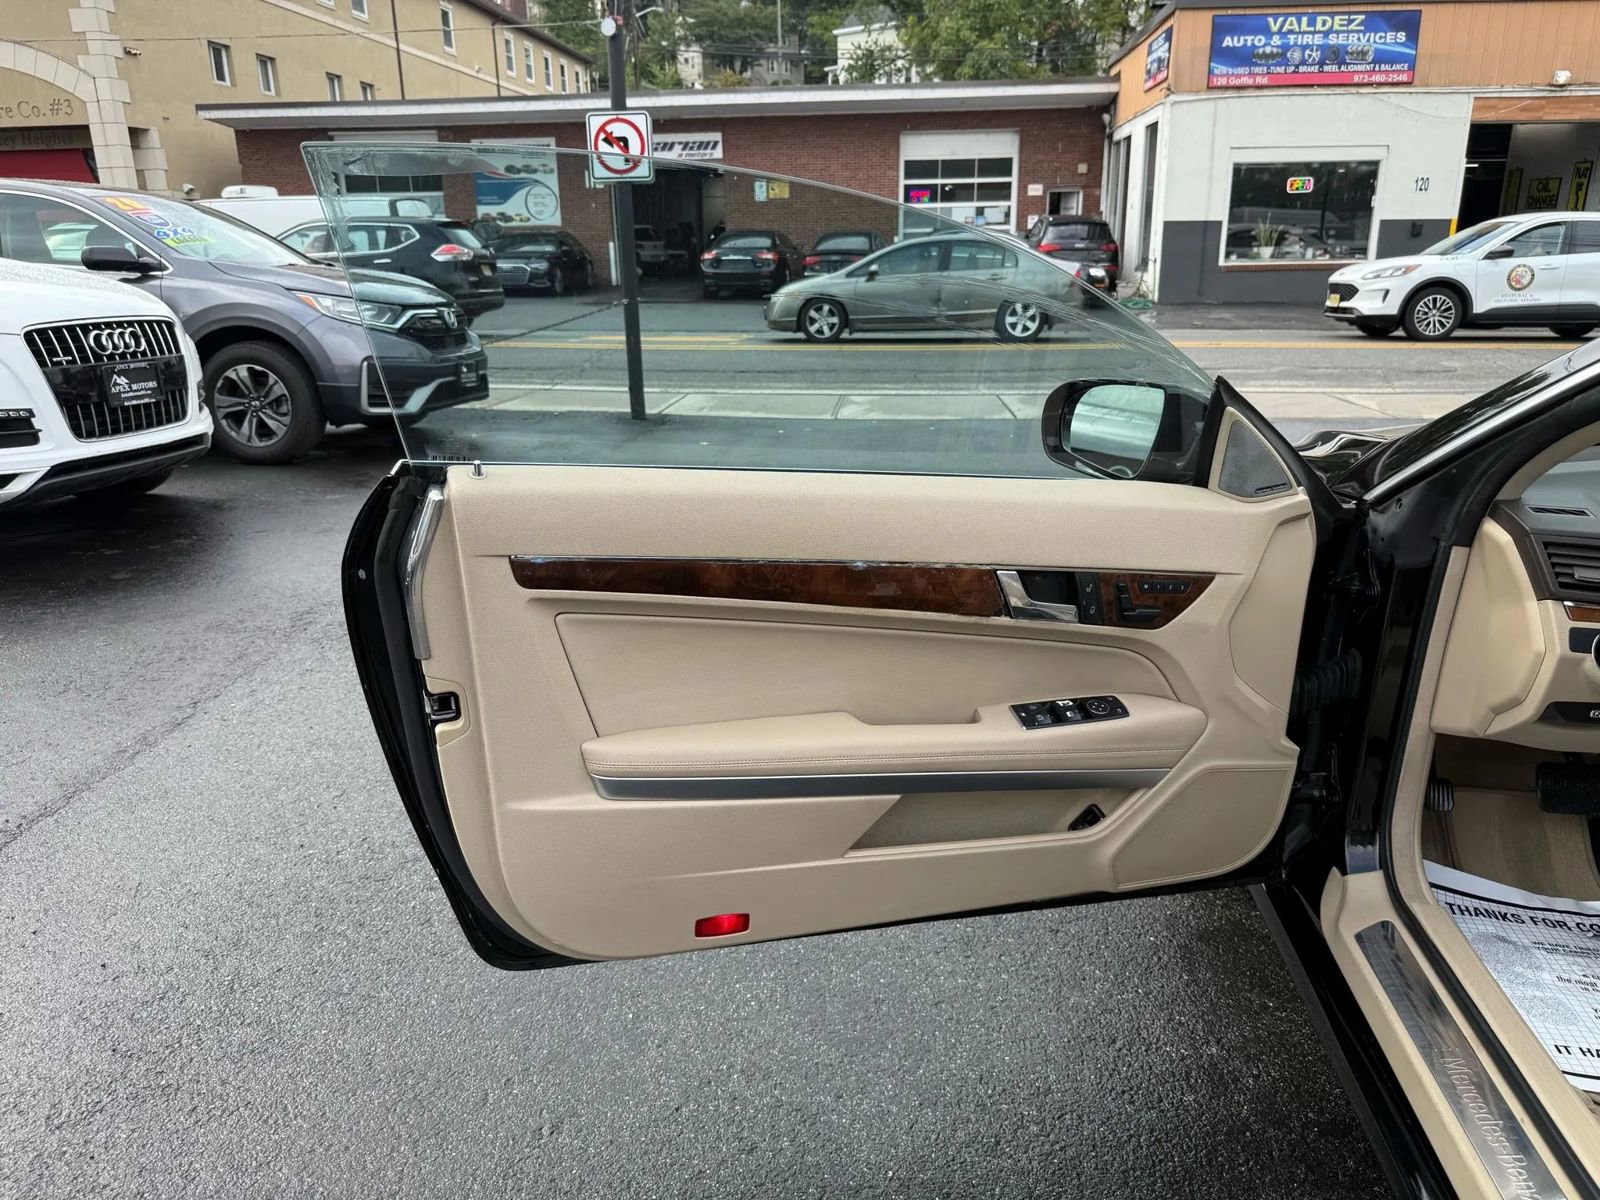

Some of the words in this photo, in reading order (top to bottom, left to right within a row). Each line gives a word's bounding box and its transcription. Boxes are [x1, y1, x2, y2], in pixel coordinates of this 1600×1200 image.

[1267, 15, 1366, 33] VALDEZ
[1222, 36, 1265, 47] AUTO
[1270, 35, 1282, 46] &
[1287, 34, 1323, 45] TIRE
[1328, 32, 1406, 44] SERVICES
[1250, 66, 1267, 74] TIRES
[1299, 65, 1320, 73] BRAKE
[1323, 64, 1339, 72] WEEL
[1380, 63, 1409, 71] BALANCE
[1213, 77, 1227, 85] 120
[1353, 74, 1408, 82] 973-460-2546
[17, 101, 46, 118] Co.
[49, 98, 74, 116] #3
[21, 131, 75, 148] Heights
[652, 140, 720, 152] arian
[1289, 178, 1312, 192] OPEN
[1414, 177, 1430, 192] 120
[111, 384, 130, 393] APEX
[131, 381, 158, 391] MOTORS
[1445, 902, 1526, 924] THANKS
[1529, 915, 1573, 932] FOR
[1576, 922, 1600, 934] CO
[1554, 1044, 1572, 1056] IT
[1579, 1046, 1600, 1059] HA
